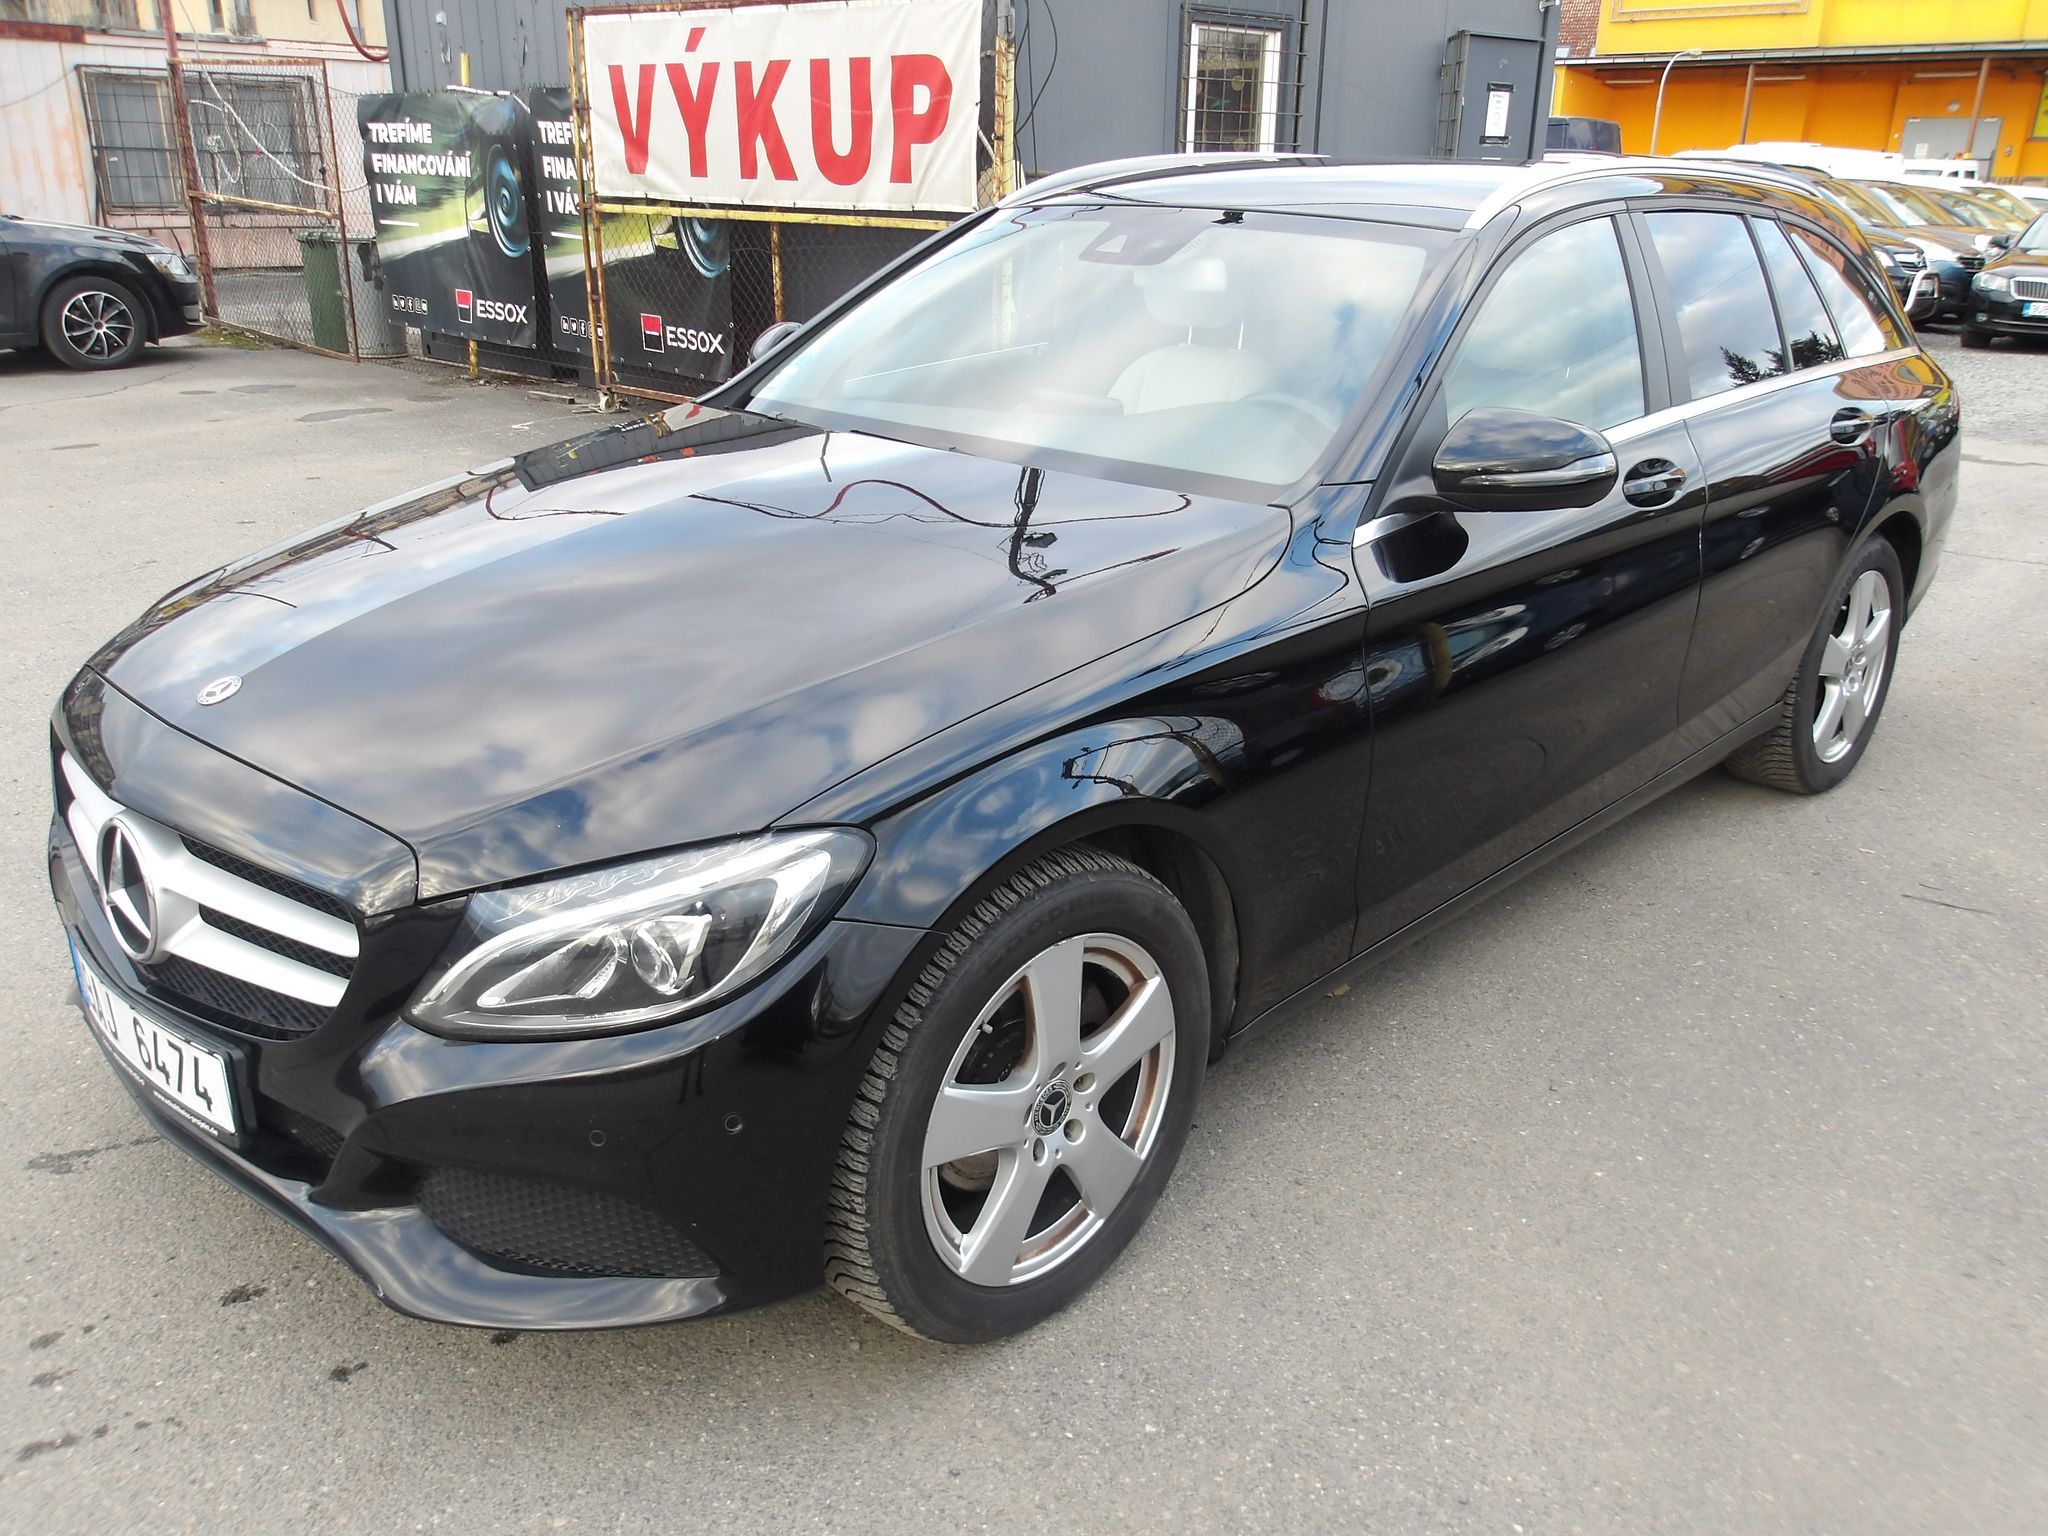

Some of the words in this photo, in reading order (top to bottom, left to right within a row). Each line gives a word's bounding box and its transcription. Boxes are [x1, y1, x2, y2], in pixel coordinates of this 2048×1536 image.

[608, 27, 952, 185] VÝKUP
[368, 118, 432, 143] TREFÍME
[372, 151, 472, 177] FINANCOVÁNÍ
[376, 185, 383, 204] I
[386, 181, 417, 206] VÁM
[546, 191, 553, 213] I
[476, 299, 528, 324] ESSOX
[666, 325, 725, 355] ESSOX
[133, 1016, 213, 1113] 6474
